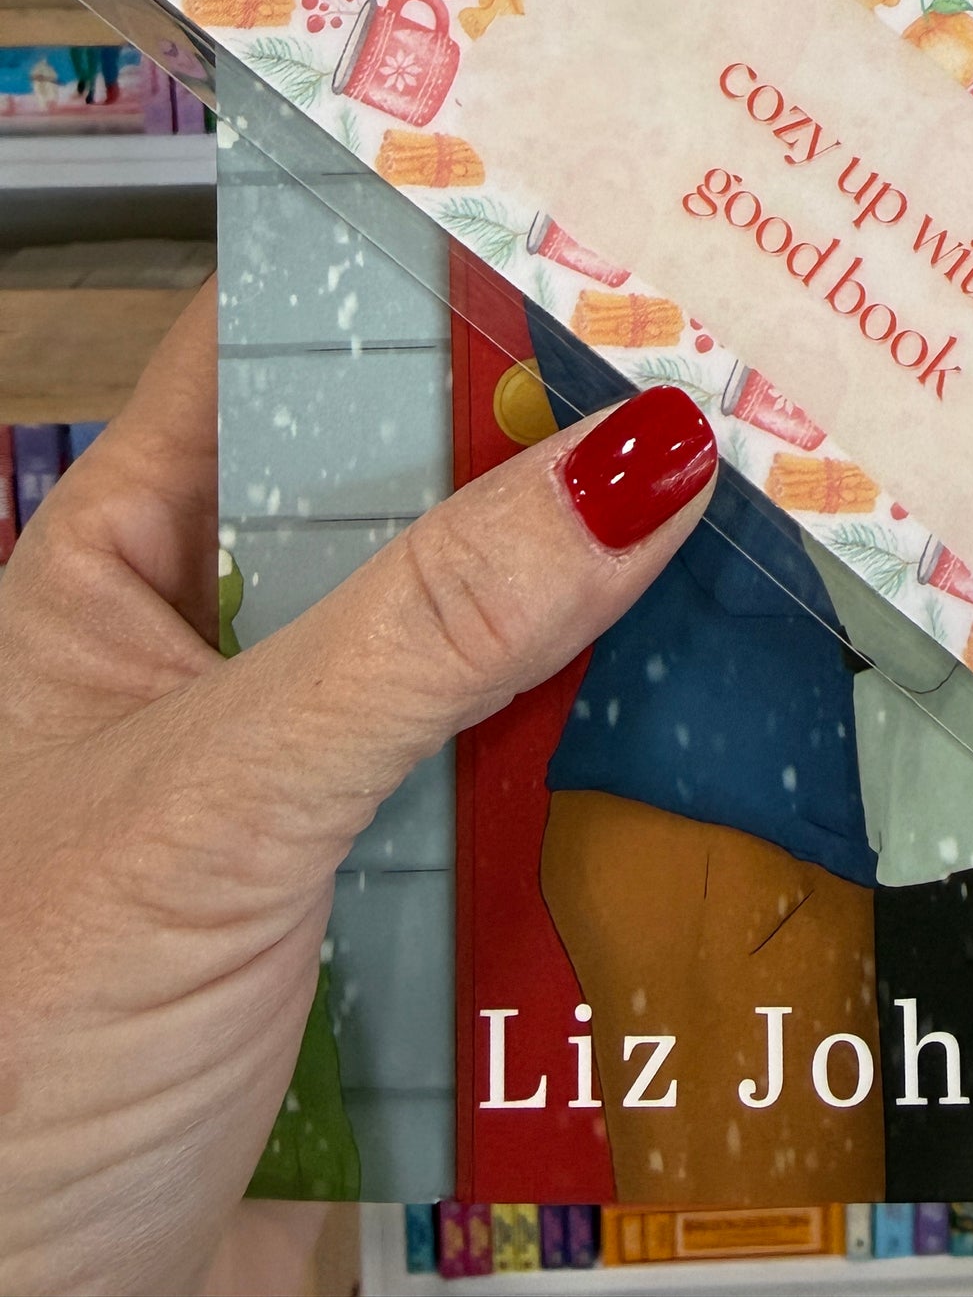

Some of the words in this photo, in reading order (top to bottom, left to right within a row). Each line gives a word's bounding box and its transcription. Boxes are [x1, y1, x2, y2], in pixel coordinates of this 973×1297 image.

[719, 62, 842, 165] cozy
[837, 156, 908, 229] up
[682, 167, 841, 287] good
[824, 257, 962, 401] book
[476, 1003, 680, 1111] Liz
